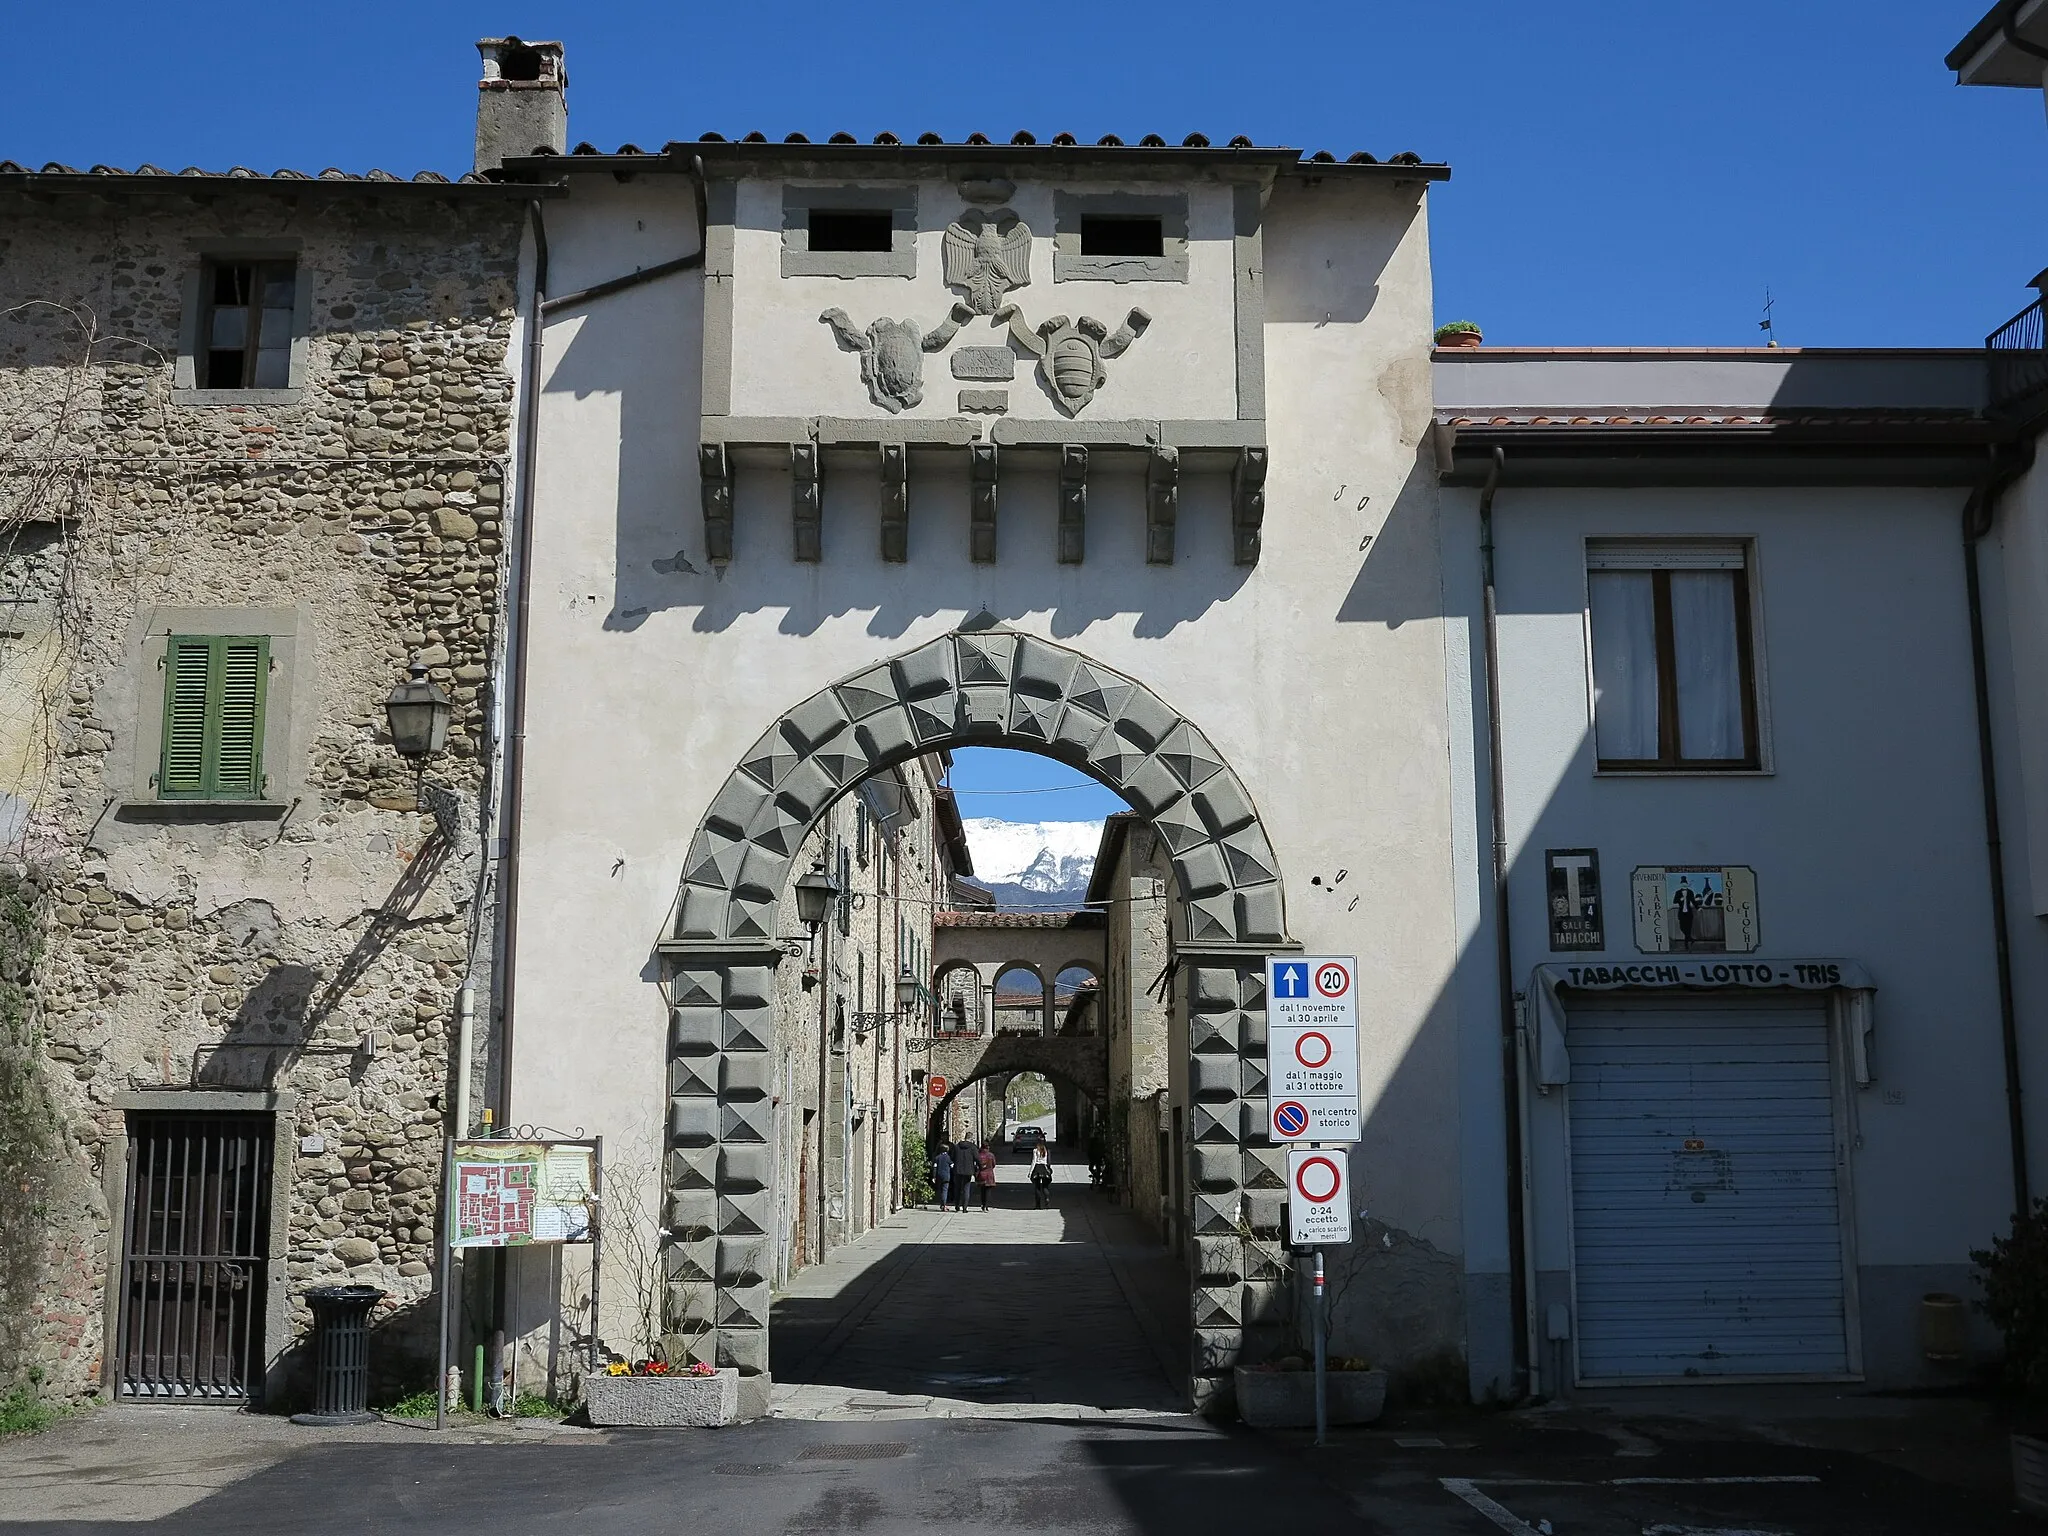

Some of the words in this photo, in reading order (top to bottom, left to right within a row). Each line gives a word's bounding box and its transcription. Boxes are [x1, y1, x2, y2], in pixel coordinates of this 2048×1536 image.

[1552, 855, 1590, 917] T
[1725, 871, 1734, 912] LOTTO
[1652, 885, 1662, 951] TABACCHI
[1562, 920, 1581, 930] SALI
[1742, 901, 1751, 951] GIOCHI
[1555, 932, 1600, 944] TABACCHI
[1568, 966, 1680, 986] TABACCHI
[1701, 964, 1773, 984] LOTTO
[1794, 964, 1841, 984] TRIS
[1323, 972, 1341, 990] 20
[1280, 1004, 1294, 1012] dal
[1302, 1004, 1346, 1012] novembre
[1287, 1014, 1296, 1023] al
[1298, 1014, 1311, 1023] 30
[1313, 1014, 1339, 1025] aprile
[1286, 1071, 1300, 1080] dal
[1309, 1070, 1343, 1082] maggio
[1286, 1082, 1295, 1091] al
[1297, 1082, 1308, 1091] 31
[1310, 1082, 1344, 1091] ottobre
[1312, 1108, 1326, 1116] nel
[1328, 1108, 1358, 1116] centro
[1320, 1118, 1350, 1127] storico
[310, 1138, 316, 1147] 2
[1305, 1216, 1338, 1224] eccetto
